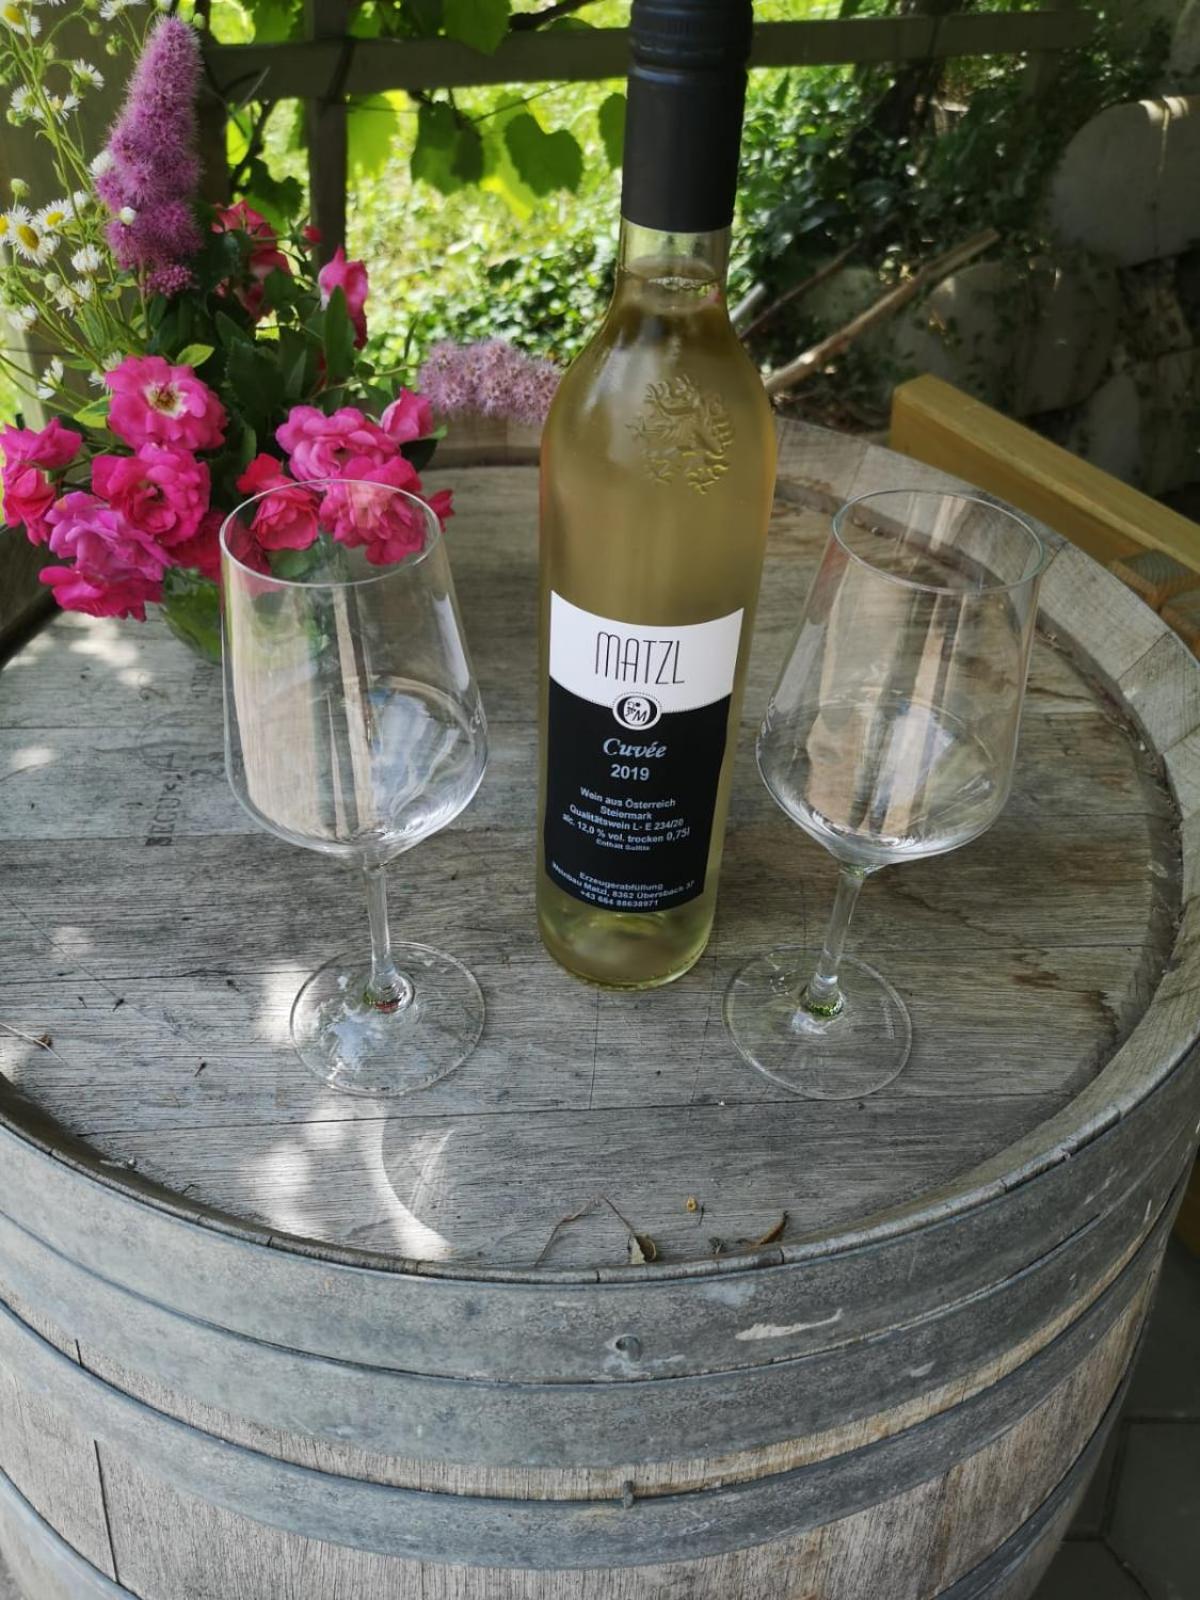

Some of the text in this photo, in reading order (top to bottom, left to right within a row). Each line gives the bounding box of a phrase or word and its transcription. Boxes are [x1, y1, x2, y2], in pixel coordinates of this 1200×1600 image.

[594, 631, 685, 685] MATZL
[603, 738, 667, 758] Cuvée
[611, 764, 650, 781] 2019
[580, 786, 676, 809] Wein aus Österreich
[600, 805, 652, 820] Steiermark
[627, 835, 664, 843] trocken
